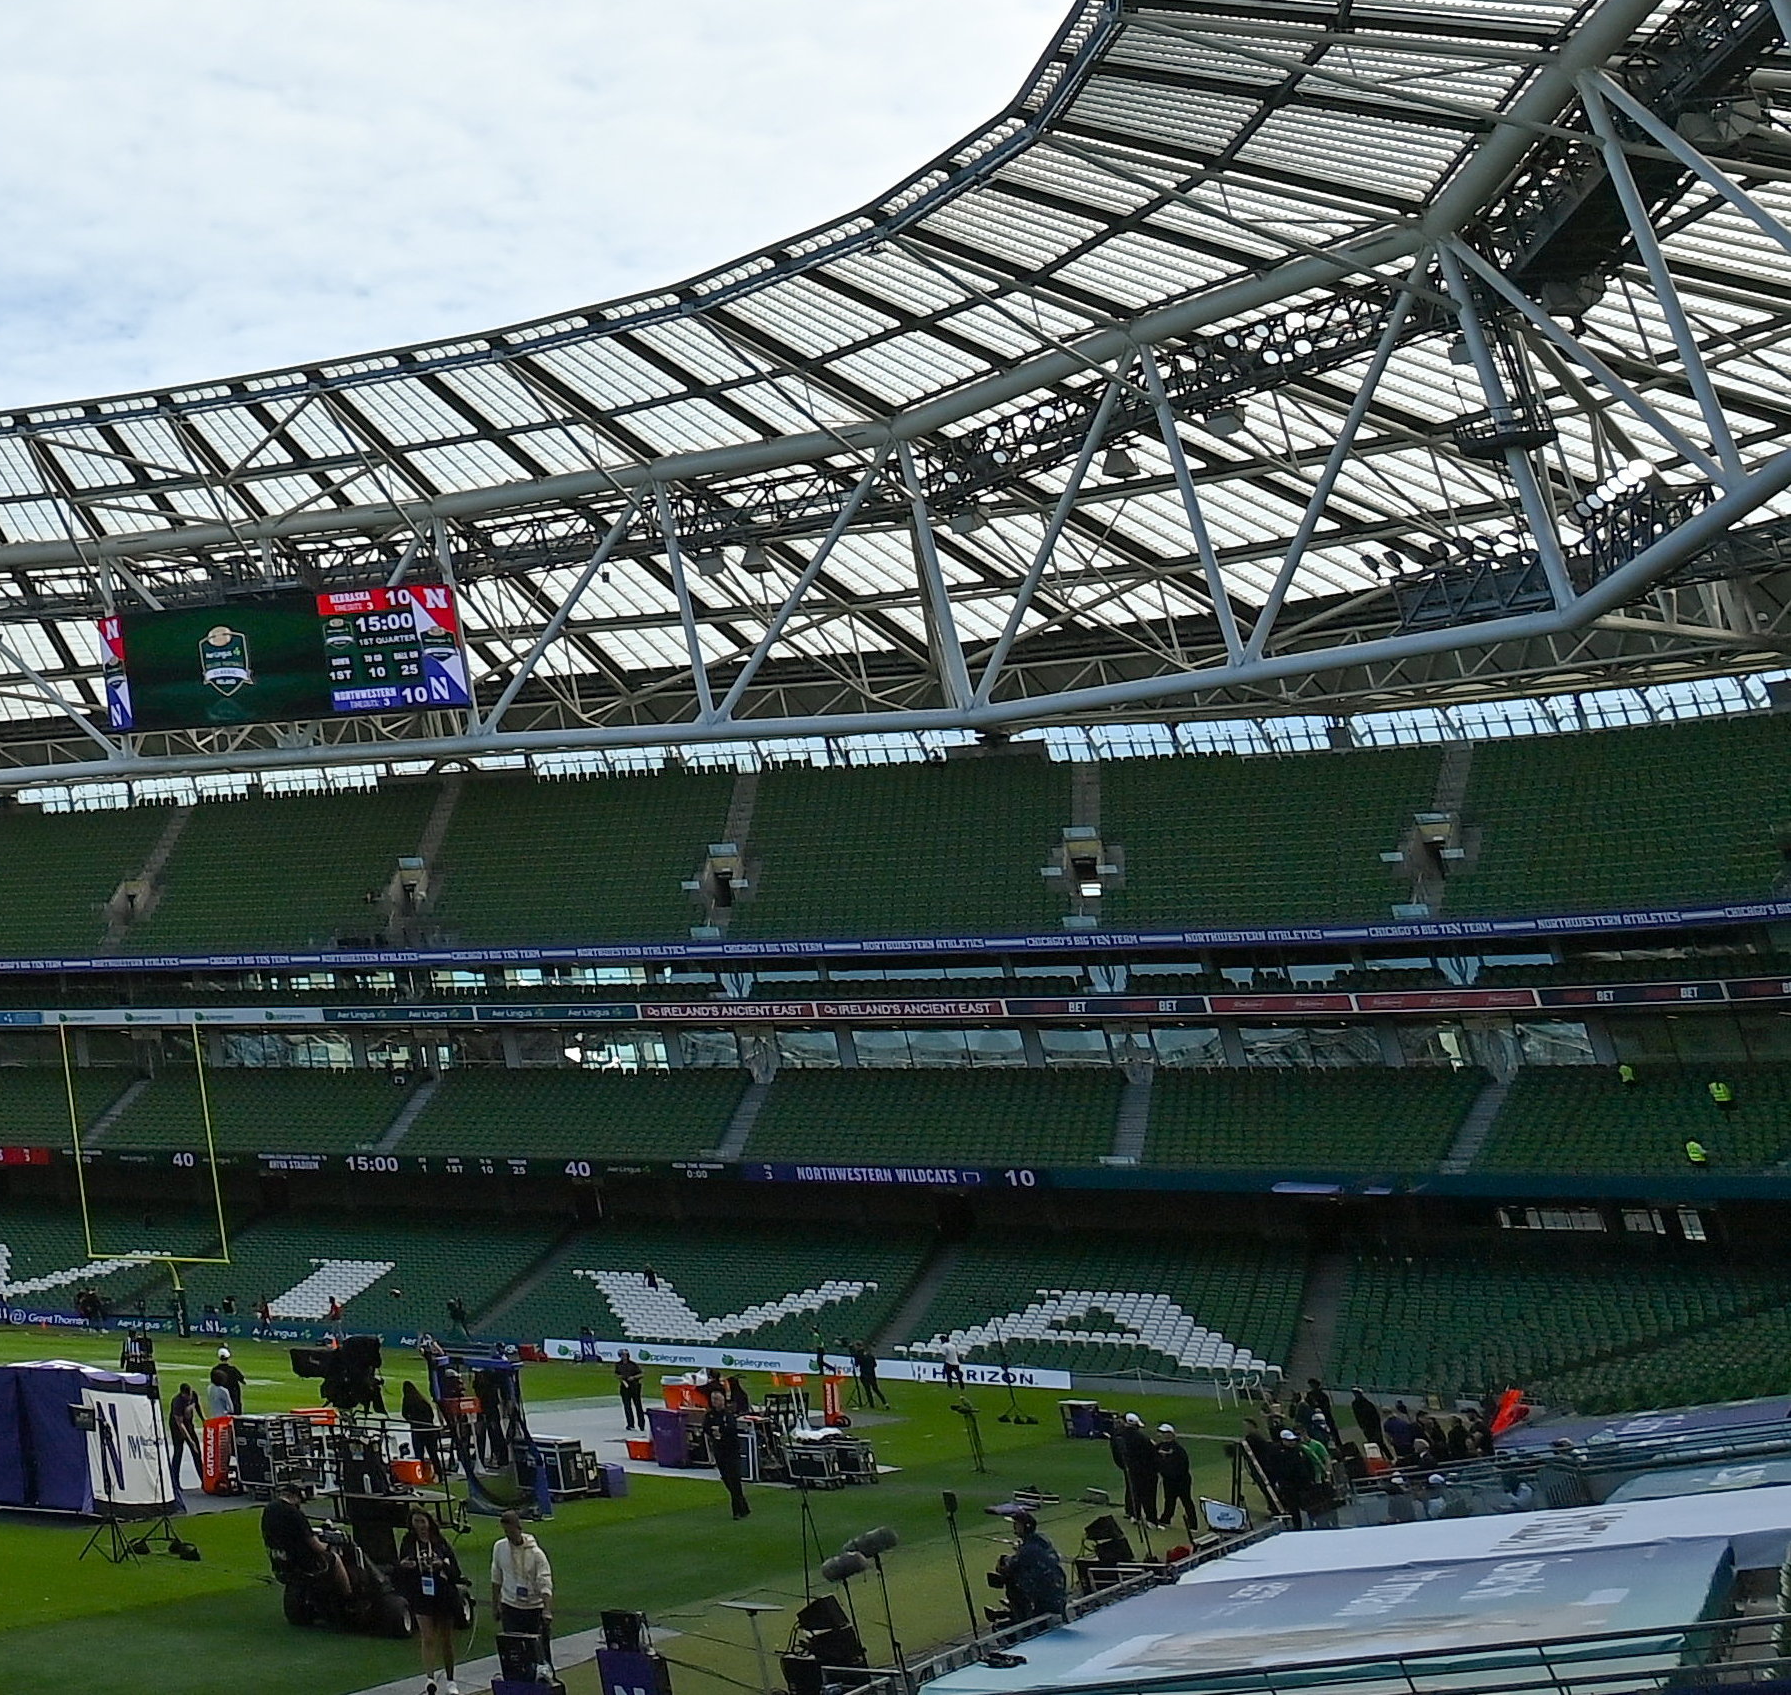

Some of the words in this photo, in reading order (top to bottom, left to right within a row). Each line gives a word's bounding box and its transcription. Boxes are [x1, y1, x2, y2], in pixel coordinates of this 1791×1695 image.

[385, 590, 410, 605] 10
[423, 588, 448, 608] N
[367, 602, 374, 610] 3
[356, 613, 413, 632] 15:00
[359, 637, 374, 646] 1ST
[375, 634, 416, 644] QUARTER
[329, 670, 352, 681] 1ST
[369, 667, 386, 677] 10
[401, 664, 418, 675] 25
[402, 687, 428, 703] 10
[429, 677, 450, 700] N
[383, 698, 390, 706] 3
[1725, 904, 1777, 918] CHICAGO'S
[1537, 915, 1621, 930] NORTHWESTERN
[1622, 911, 1682, 925] ATHLETICS
[1184, 931, 1266, 943] NORTHWESTERN
[1267, 928, 1323, 941] ATHLETICS
[1367, 925, 1420, 937] CHICAGO'S
[1421, 924, 1438, 936] BIG
[1439, 923, 1461, 936] TEN
[1461, 921, 1494, 934] TEAM
[1596, 990, 1614, 1002] BET
[1680, 987, 1698, 998] BET
[660, 1006, 719, 1017] IRELAND'S
[721, 1005, 772, 1016] ANCIENT
[772, 1005, 803, 1015] EAST
[839, 1004, 901, 1016] IRELAND'S
[903, 1003, 960, 1014] ANCIENT
[960, 1003, 991, 1013] EAST
[1069, 1001, 1086, 1012] BET
[1159, 1000, 1177, 1011] BET
[173, 1153, 194, 1167] 40
[345, 1156, 399, 1172] 15:00
[481, 1165, 494, 1174] 10
[512, 1166, 526, 1175] 25
[565, 1161, 591, 1176] 40
[796, 1167, 893, 1182] NORTHWESTERN
[895, 1168, 958, 1184] WILDCATS
[1005, 1169, 1035, 1186] 10
[400, 1336, 417, 1345] Aer
[583, 1339, 596, 1356] N
[96, 1401, 126, 1491] N
[206, 1427, 215, 1477] GATORADE
